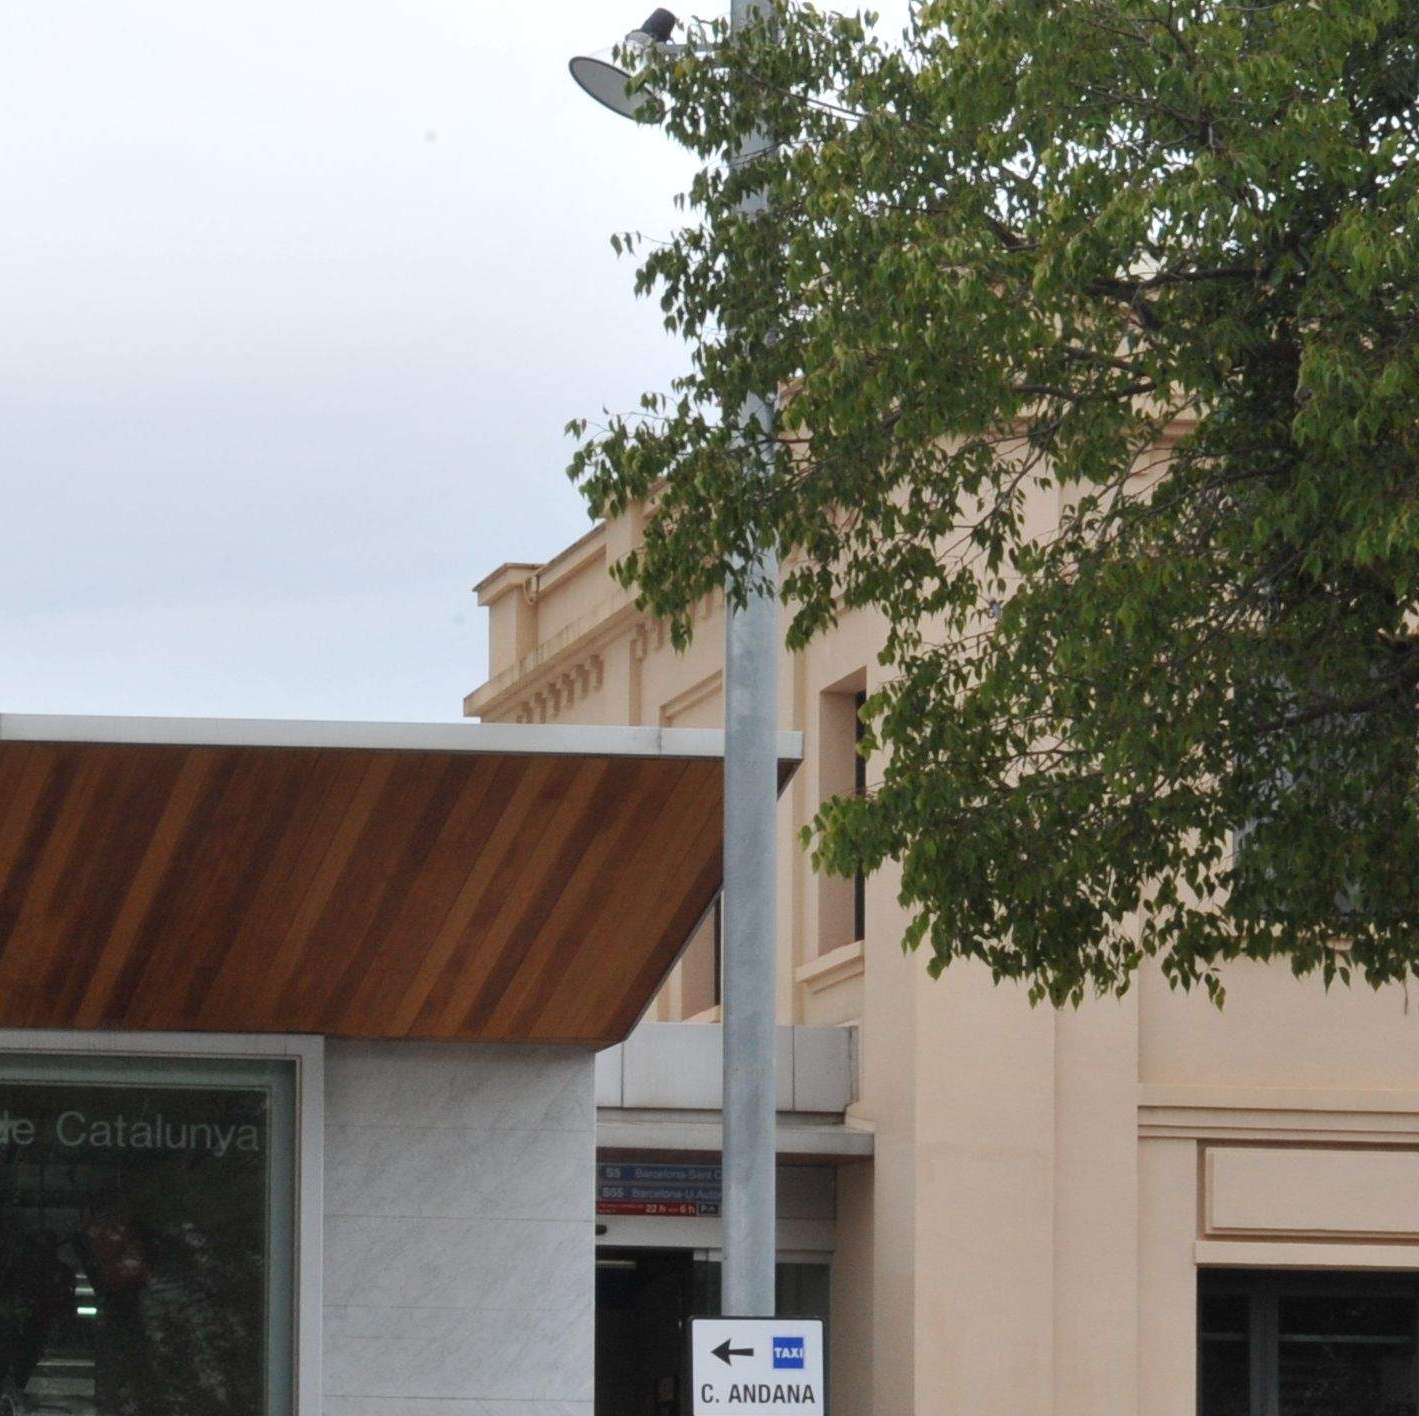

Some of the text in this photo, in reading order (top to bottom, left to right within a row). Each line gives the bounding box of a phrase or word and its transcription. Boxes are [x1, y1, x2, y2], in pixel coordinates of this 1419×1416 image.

[56, 1110, 259, 1158] Catalunya
[774, 1347, 803, 1358] TAXI
[701, 1384, 816, 1404] C. ANDANA
